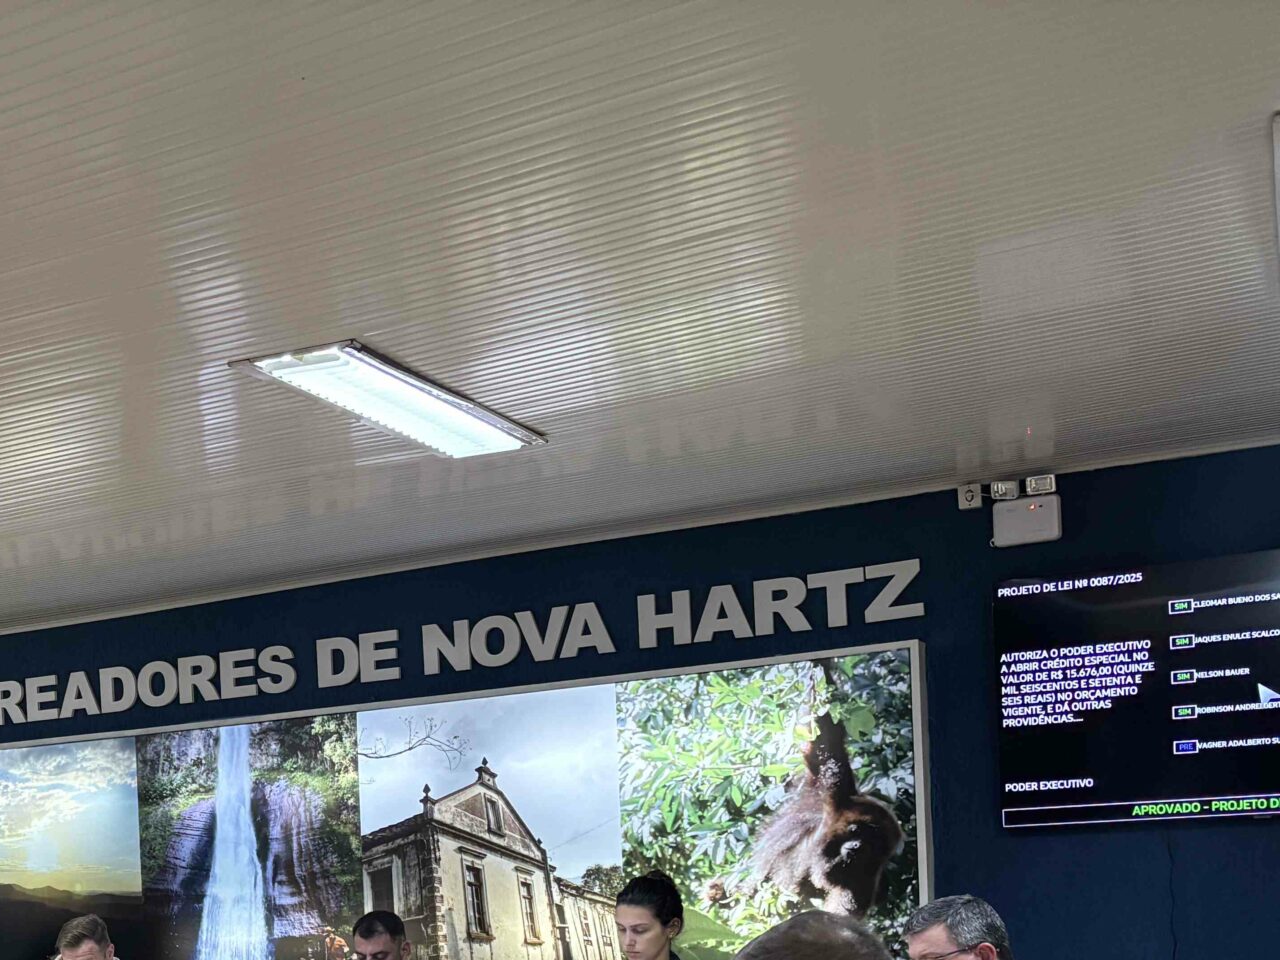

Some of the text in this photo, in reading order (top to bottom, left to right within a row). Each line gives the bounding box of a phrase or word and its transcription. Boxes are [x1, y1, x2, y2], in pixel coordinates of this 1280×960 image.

[998, 572, 1143, 597] PROJETO DE LEI Nº 0087/2025
[1174, 602, 1188, 610] SIM
[1193, 598, 1228, 608] CLEOMAR
[1228, 595, 1253, 604] BUENO
[1255, 593, 1270, 602] DOS
[315, 629, 402, 689] DE
[421, 601, 617, 676] NOVA
[636, 558, 925, 650] HARTZ
[1175, 637, 1189, 645] SIM
[1195, 634, 1221, 644] JAQUES
[1222, 631, 1251, 641] ENULCE
[1000, 639, 1151, 663] AUTORIZA O PODER EXECUTIVO
[1000, 651, 1149, 673] A ABRIR CRÉDITO ESPECIAL NO
[1001, 661, 1155, 684] VALOR DE R$ 15.676,00 (QUINZE
[1195, 670, 1224, 679] NELSON
[1225, 667, 1250, 677] BAUER
[1001, 674, 1142, 695] MIL SEISCENTOS E SETENTA E
[1001, 686, 1138, 706] SEIS REAIS) NO ORÇAMENTO
[1002, 699, 1112, 717] VIGENTE, E DÁ OUTRAS
[1178, 708, 1191, 716] SIM
[1197, 704, 1234, 714] ROBINSON
[1179, 743, 1193, 751] PRE
[1228, 737, 1271, 748] ADALBERTO
[1005, 778, 1094, 792] PODER EXECUTIVO
[1132, 802, 1201, 816] APROVADO
[1212, 798, 1267, 812] PROJETO
[1270, 797, 1280, 809] D
